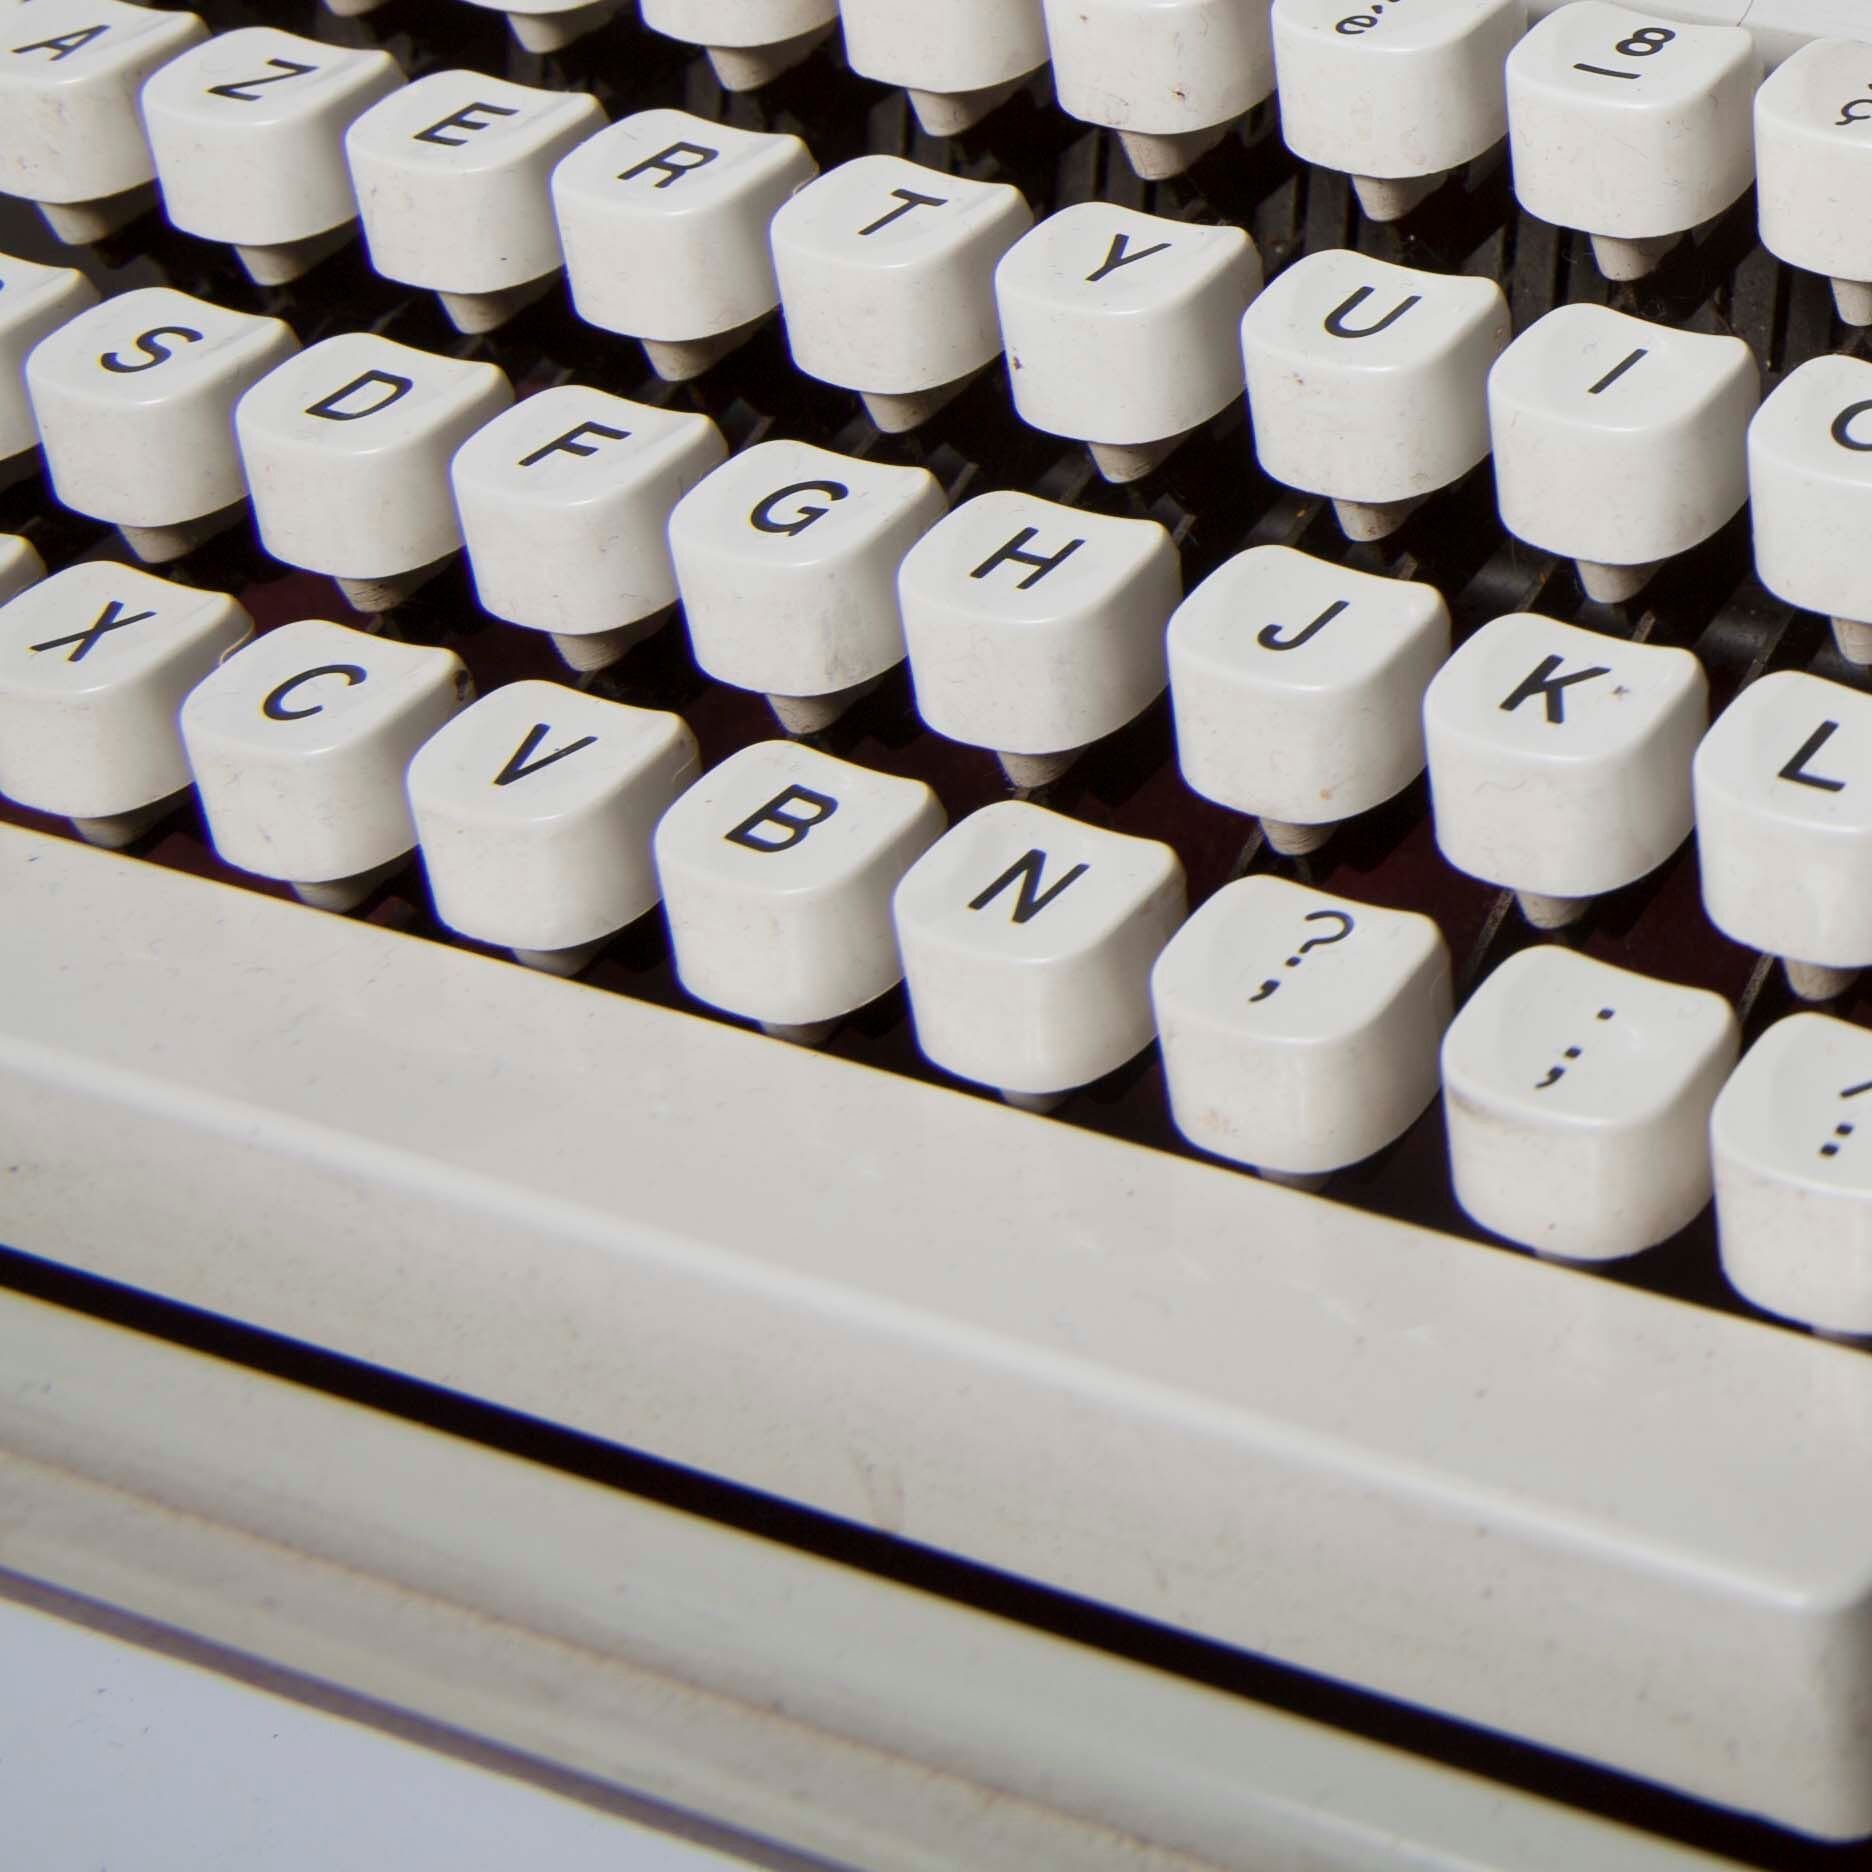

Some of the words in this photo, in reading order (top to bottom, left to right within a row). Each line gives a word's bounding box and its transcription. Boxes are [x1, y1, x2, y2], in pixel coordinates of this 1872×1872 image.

[11, 23, 111, 62] A
[1614, 26, 1677, 58] 8
[206, 57, 318, 103] Z
[412, 101, 519, 148] E
[616, 140, 720, 190] R
[857, 187, 949, 237] T
[1084, 232, 1173, 283] Y
[1323, 285, 1423, 340] U
[99, 325, 205, 375] S
[304, 368, 414, 422] D
[517, 420, 632, 468] F
[749, 479, 850, 538] G
[968, 525, 1087, 591] H
[28, 599, 158, 664] X
[1256, 599, 1351, 653] J
[261, 663, 368, 722] C
[1498, 653, 1612, 726] K
[492, 722, 599, 787] V
[1776, 719, 1846, 794] L
[723, 783, 839, 854] B
[967, 848, 1091, 925] N
[1284, 909, 1355, 968] ?
